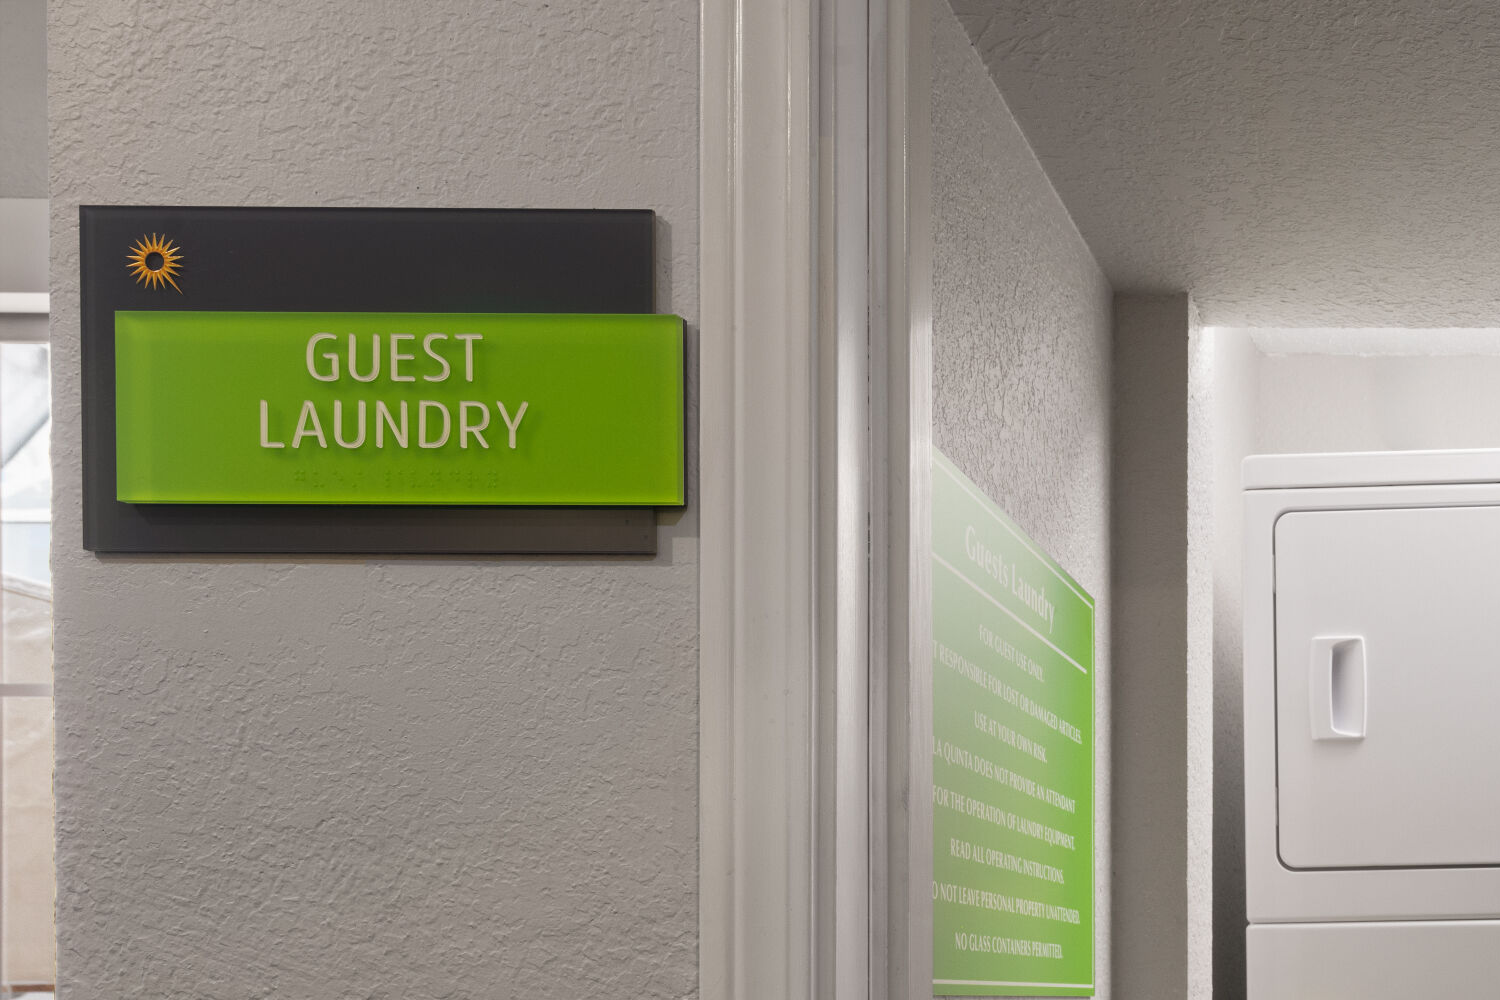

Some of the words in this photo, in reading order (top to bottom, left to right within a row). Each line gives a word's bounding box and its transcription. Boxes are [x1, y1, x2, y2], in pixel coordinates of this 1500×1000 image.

[305, 332, 485, 383] GUEST
[259, 400, 529, 450] LAUNDRY
[1011, 563, 1055, 634] Laundry
[978, 624, 994, 649] FOR
[994, 635, 1015, 663] GUEST
[1015, 650, 1027, 672] USE
[939, 643, 988, 689] RESPONSIBLE
[988, 673, 1002, 697] FOR
[1003, 683, 1019, 707] LOST
[1019, 693, 1030, 713] OR
[1030, 700, 1058, 730] DAMAGED
[974, 710, 987, 732] USE
[988, 718, 997, 737] AT
[997, 721, 1016, 748] YOUR
[1016, 733, 1033, 755] OWN
[943, 742, 973, 771] QUINTA
[974, 755, 993, 779] DOES
[993, 763, 1009, 785] NOT
[1009, 771, 1036, 798] PROVIDE
[1036, 784, 1045, 801] AN
[1045, 787, 1076, 814] ATTENDANT
[933, 785, 949, 807] FOR
[950, 791, 966, 813] THE
[966, 797, 1006, 827] OPERATION
[1006, 812, 1017, 831] OF
[1016, 815, 1044, 841] LAUNDRY
[950, 837, 971, 860] READ
[972, 845, 985, 864] ALL
[985, 848, 1023, 873] OPERATING
[940, 882, 958, 904] NOT
[958, 886, 980, 907] LEAVE
[980, 890, 1015, 913] PERSONAL
[1015, 897, 1045, 918] PROPERTY
[954, 932, 968, 951] NO
[969, 933, 991, 952] GLASS
[991, 936, 1032, 956] CONTAINERS
